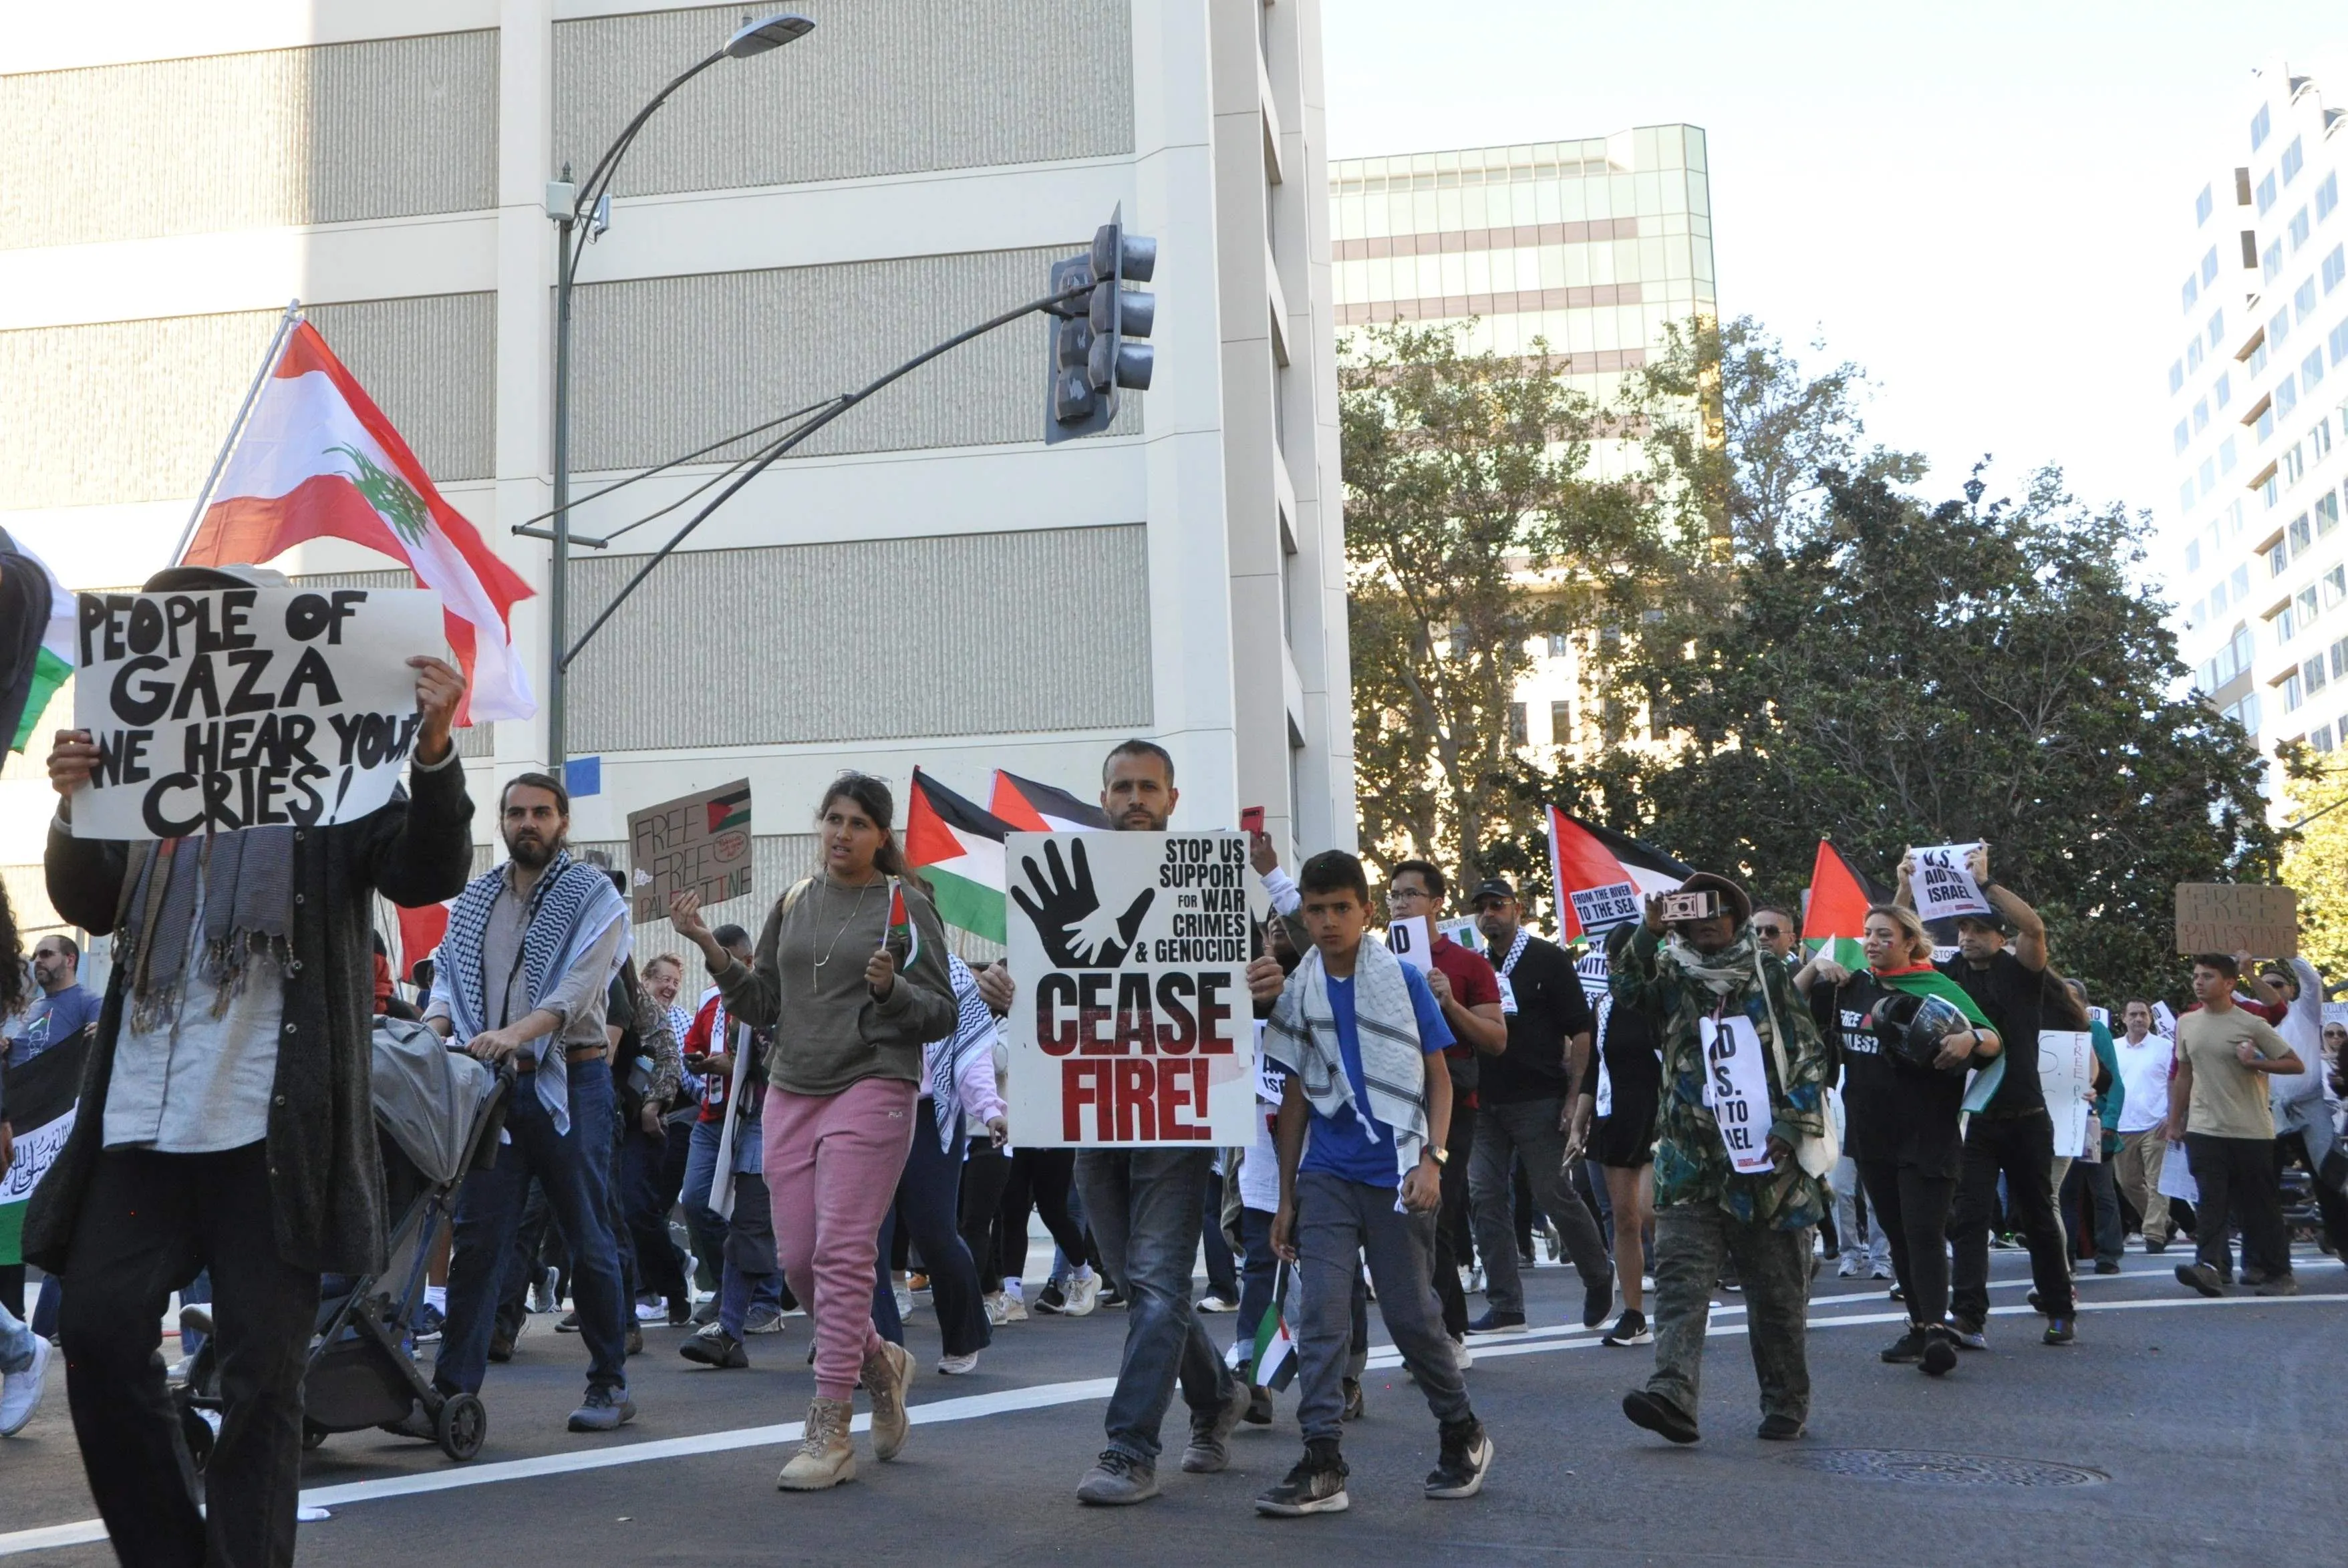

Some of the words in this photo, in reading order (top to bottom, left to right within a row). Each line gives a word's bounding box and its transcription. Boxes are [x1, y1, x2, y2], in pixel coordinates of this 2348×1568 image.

[79, 591, 257, 667] PEOPLE
[285, 591, 368, 645] OF
[110, 646, 343, 726] GAZA
[86, 728, 153, 789] WE
[185, 713, 315, 776] HEAR
[142, 766, 353, 838] CRIES!
[635, 804, 700, 858] FREE
[1166, 839, 1212, 863] STOP
[1219, 839, 1244, 863] US
[1923, 850, 1954, 869] U.S.
[653, 843, 714, 894] FREE
[1160, 864, 1244, 888] SUPPORT
[1925, 869, 1947, 885] AID
[1947, 871, 1963, 883] TO
[1179, 895, 1197, 909] FOR
[1202, 889, 1245, 913] WAR
[1572, 893, 1594, 905] FROM
[1594, 889, 1608, 901] THE
[1609, 885, 1632, 898] RIVER
[1927, 885, 1972, 903] ISRAEL
[2186, 887, 2277, 923] FREE
[1577, 906, 1592, 921] TO
[1592, 902, 1614, 919] THE
[1614, 898, 1637, 914] SEA
[1173, 914, 1245, 937] CRIMES
[1135, 942, 1147, 963] &
[1155, 939, 1246, 963] GENOCIDE
[1036, 972, 1233, 1056] CEASE
[1840, 1009, 1862, 1027] FREE
[1062, 1058, 1211, 1142] FIRE!
[1726, 1100, 1748, 1122] TO
